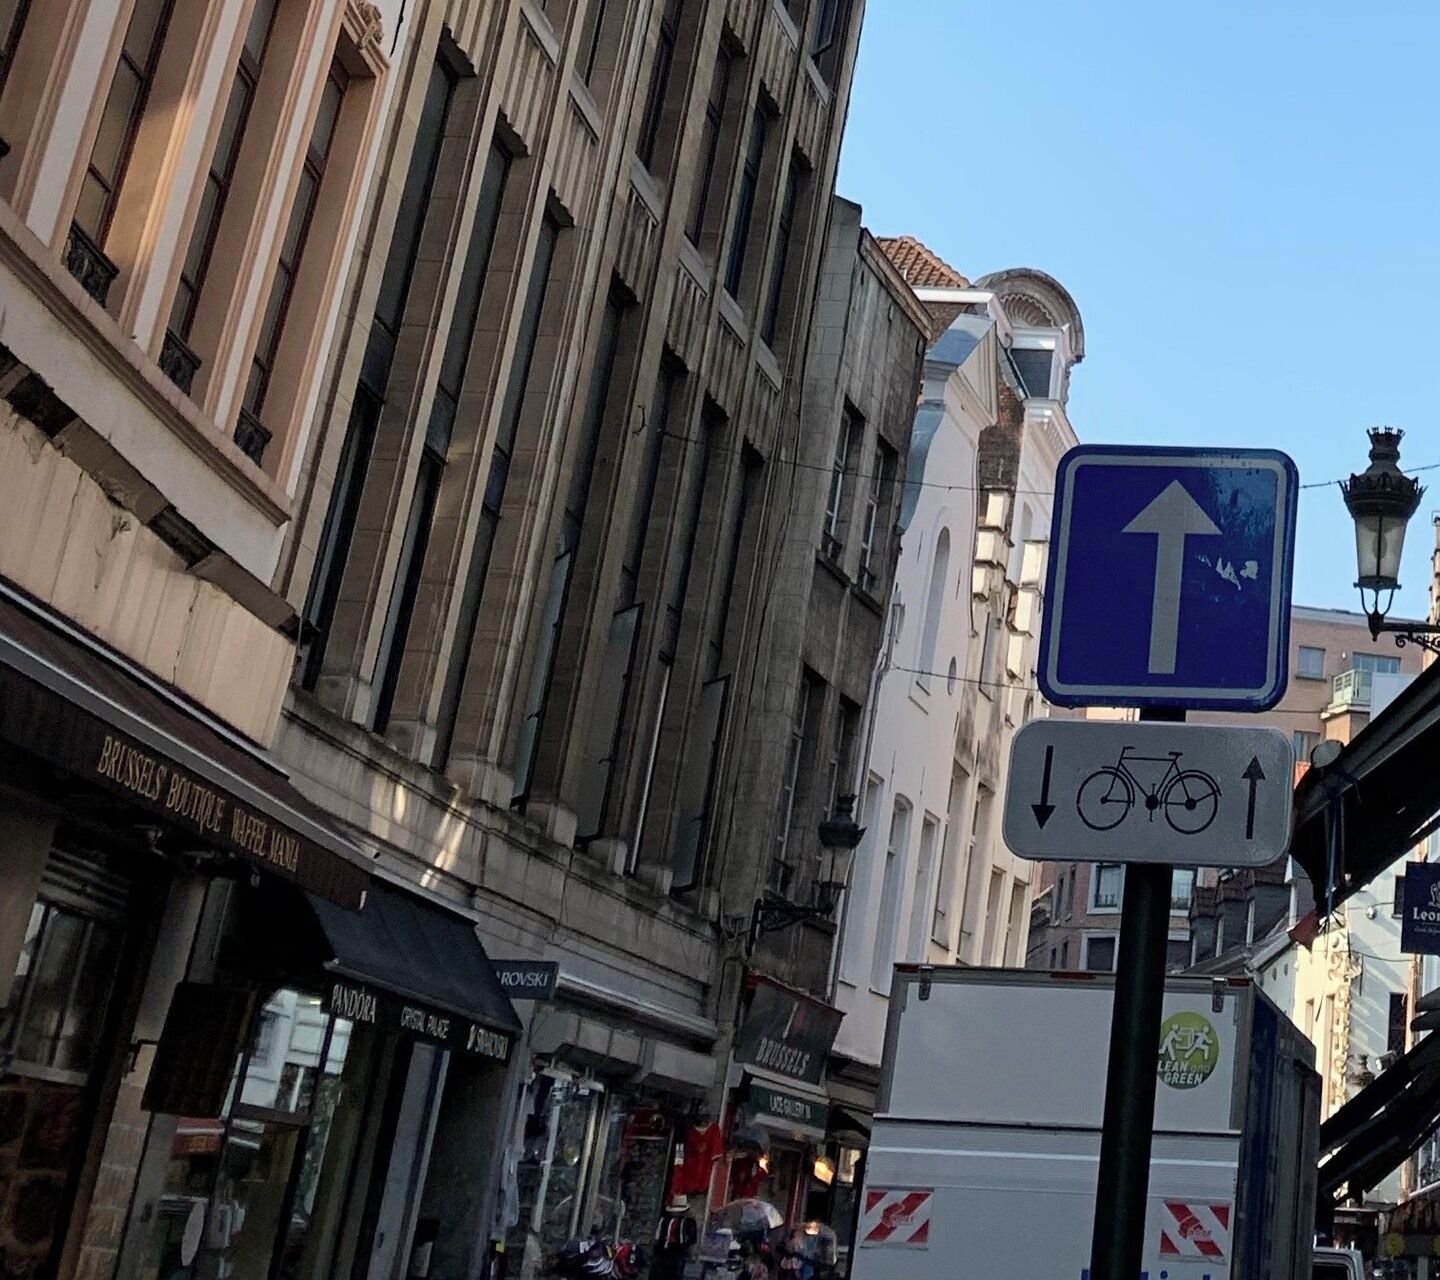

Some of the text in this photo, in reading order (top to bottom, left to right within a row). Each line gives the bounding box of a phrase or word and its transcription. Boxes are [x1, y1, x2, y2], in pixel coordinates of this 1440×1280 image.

[166, 773, 226, 834] BOUTIQUE
[497, 970, 549, 987] ROVSKI
[331, 983, 377, 1023] PANDORA
[756, 1037, 810, 1075] BRUSSELS
[1157, 1060, 1189, 1072] LEAN
[1164, 1072, 1204, 1085] GREEN
